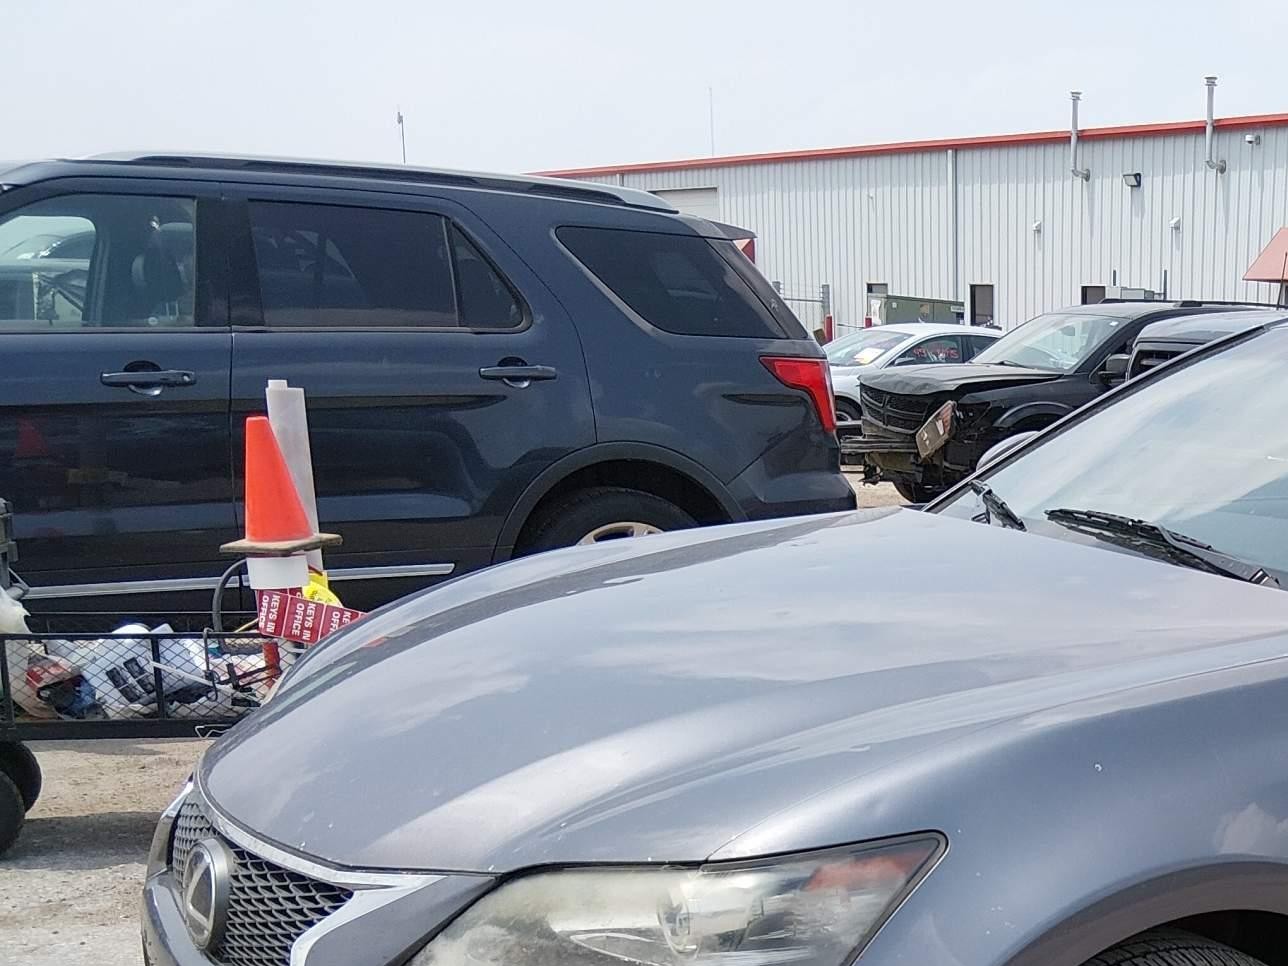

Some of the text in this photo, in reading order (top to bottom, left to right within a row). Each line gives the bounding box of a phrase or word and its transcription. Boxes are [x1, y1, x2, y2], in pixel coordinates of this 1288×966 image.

[258, 594, 270, 629] OFFICE
[266, 594, 281, 633] KEYS IN
[291, 602, 305, 637] OFFICE
[302, 602, 316, 641] KEYS IN
[329, 611, 341, 634] OFFI
[342, 610, 352, 625] KE
